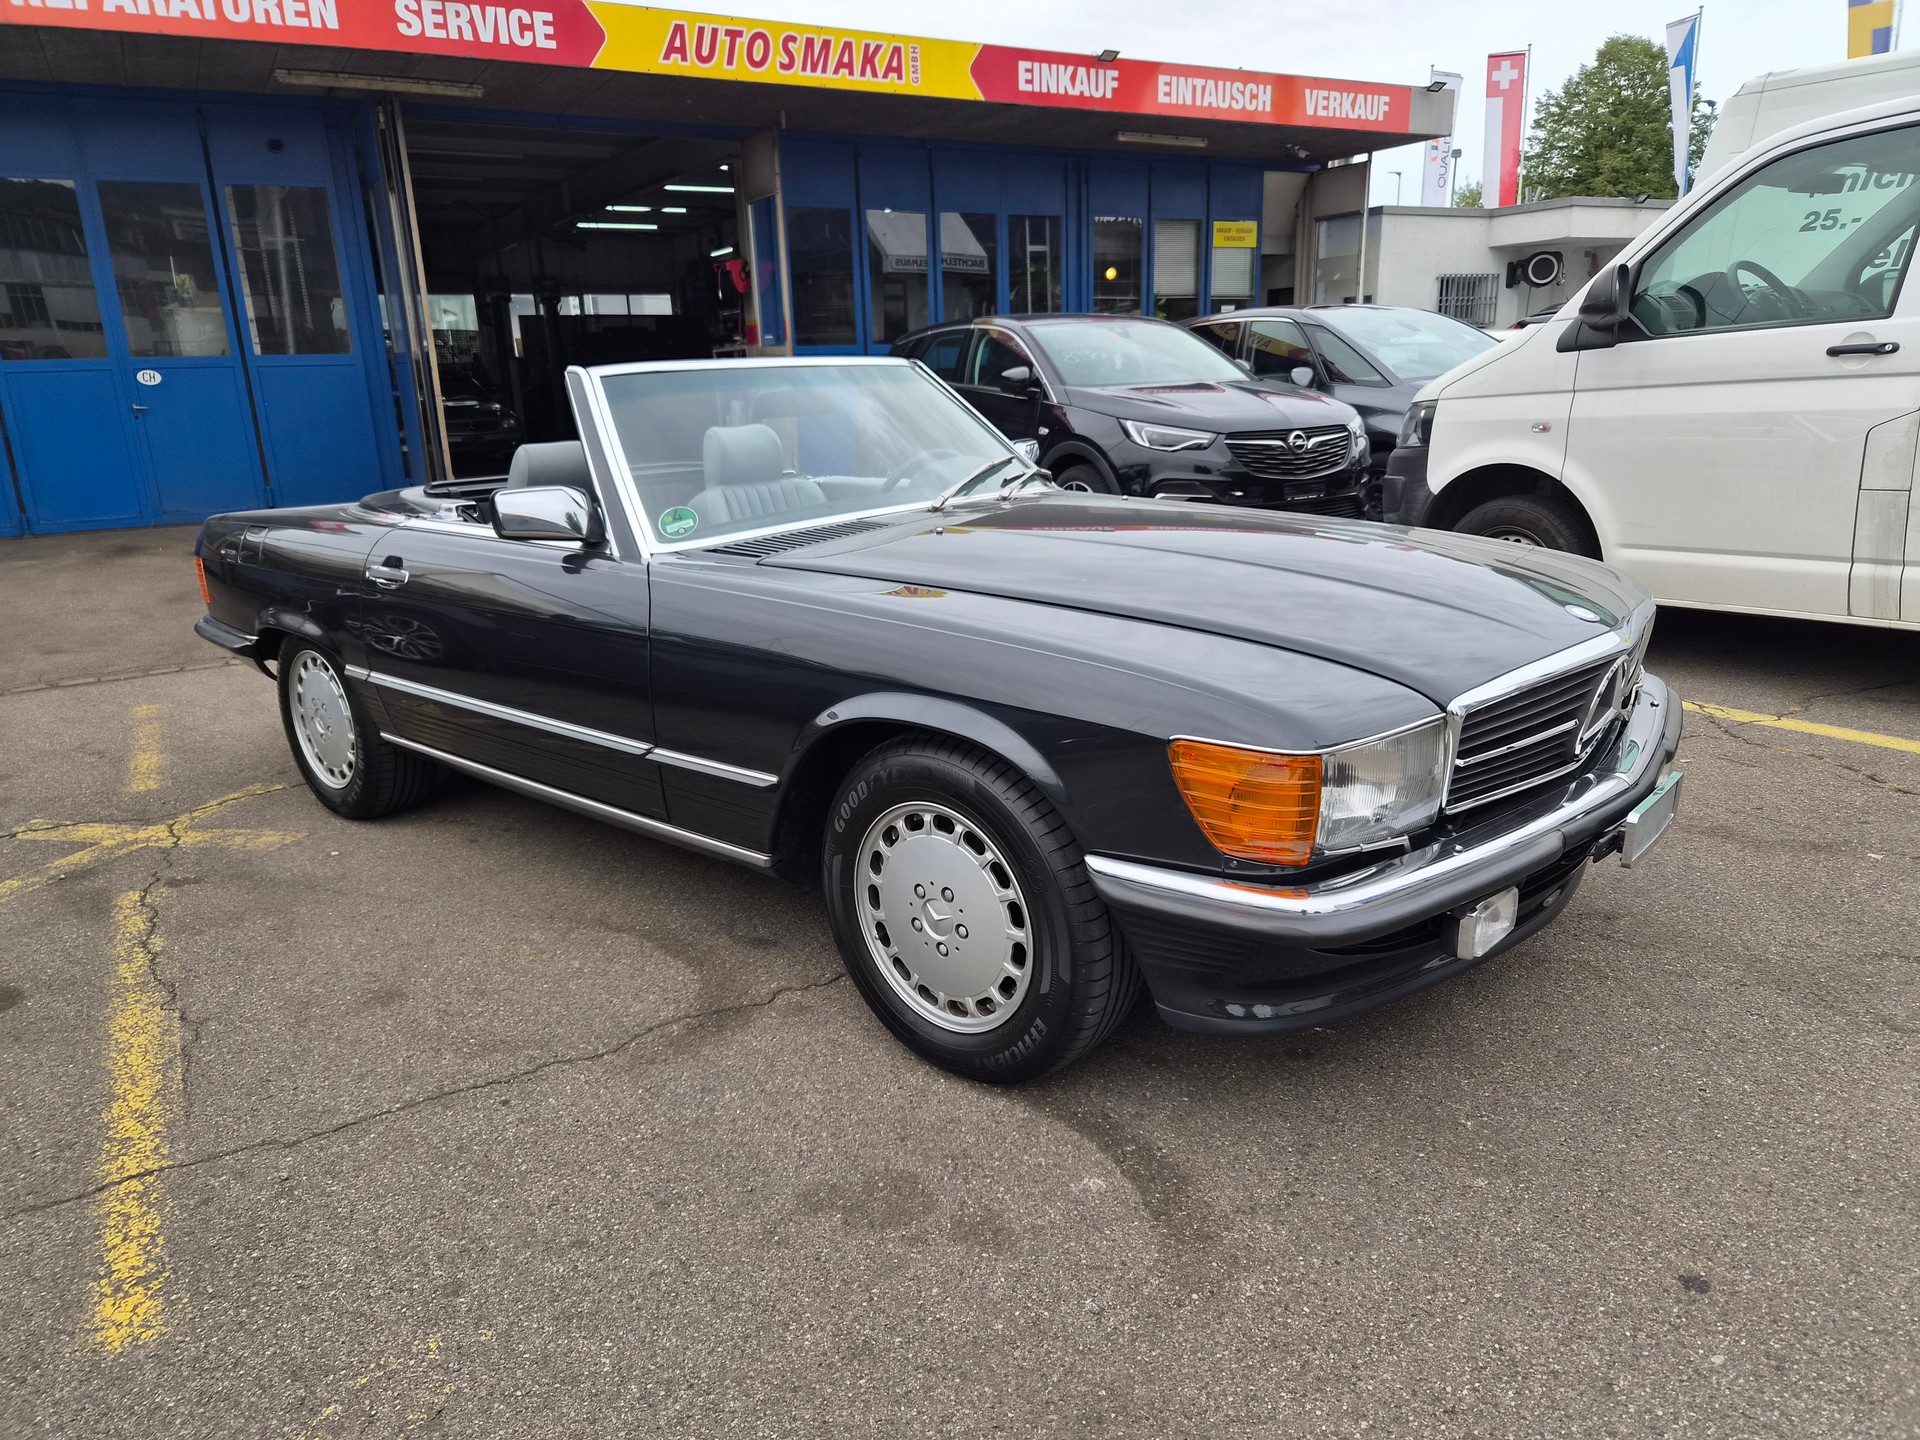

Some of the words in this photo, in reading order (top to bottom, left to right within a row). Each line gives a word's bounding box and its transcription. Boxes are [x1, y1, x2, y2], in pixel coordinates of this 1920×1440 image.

[10, 0, 339, 29] ATUREN
[395, 0, 557, 49] SERVICE
[661, 22, 771, 70] AUTO
[777, 33, 904, 82] SMAKA
[910, 45, 920, 84] GMBH
[1018, 60, 1119, 99] EINKAUF
[1158, 74, 1272, 112] EINTAUSCH
[1304, 88, 1390, 121] VERKAUF
[1438, 136, 1451, 188] QUALI
[1798, 208, 1862, 233] 25.-
[142, 371, 156, 383] CH
